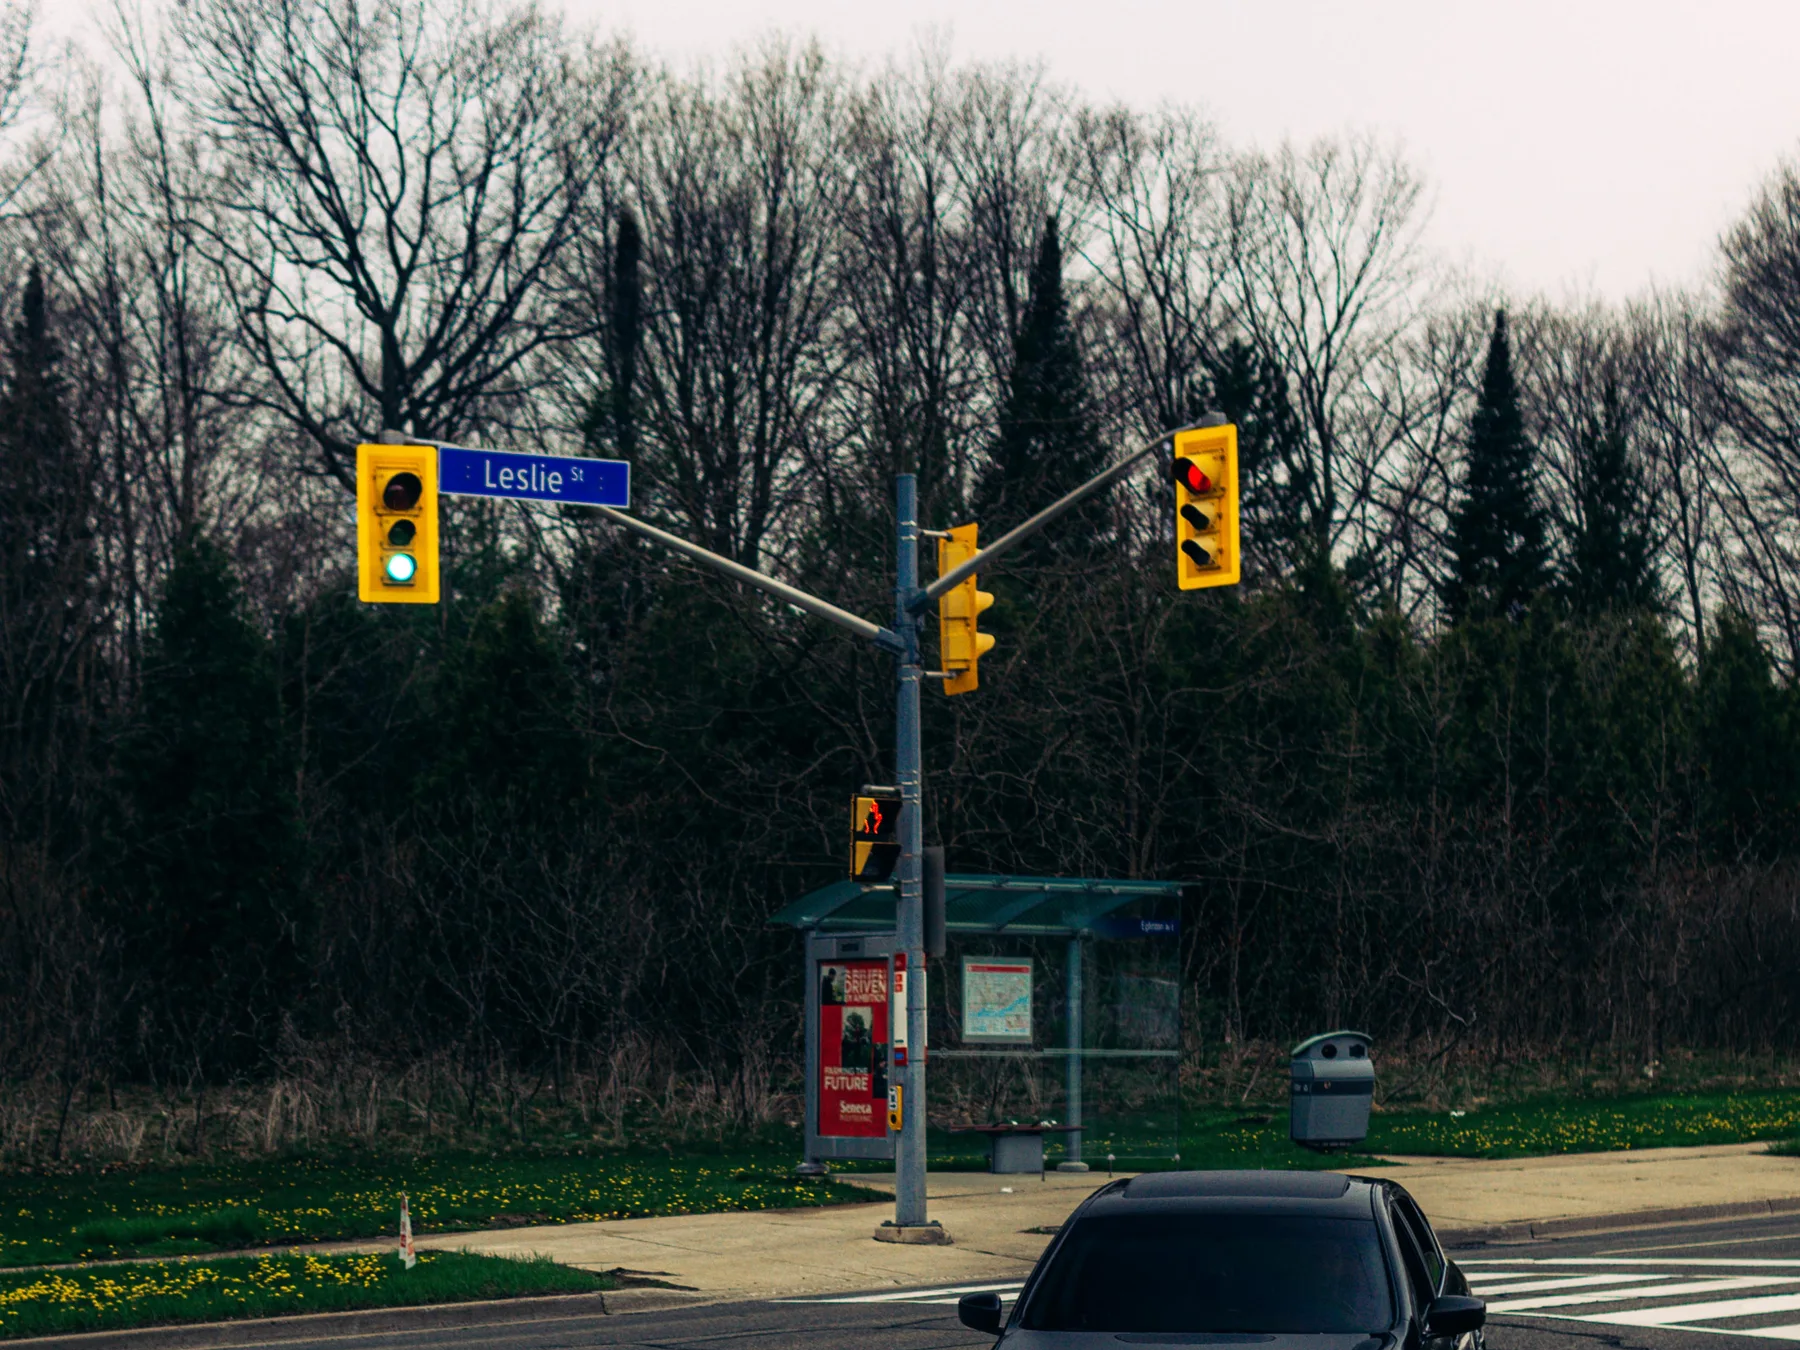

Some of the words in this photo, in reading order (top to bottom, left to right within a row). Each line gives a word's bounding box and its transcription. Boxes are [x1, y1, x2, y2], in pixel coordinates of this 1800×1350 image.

[484, 459, 563, 493] Leslie
[571, 467, 584, 482] St
[844, 979, 886, 993] DRIVEN
[824, 1076, 868, 1091] FUTURE
[840, 1100, 872, 1114] Seneca
